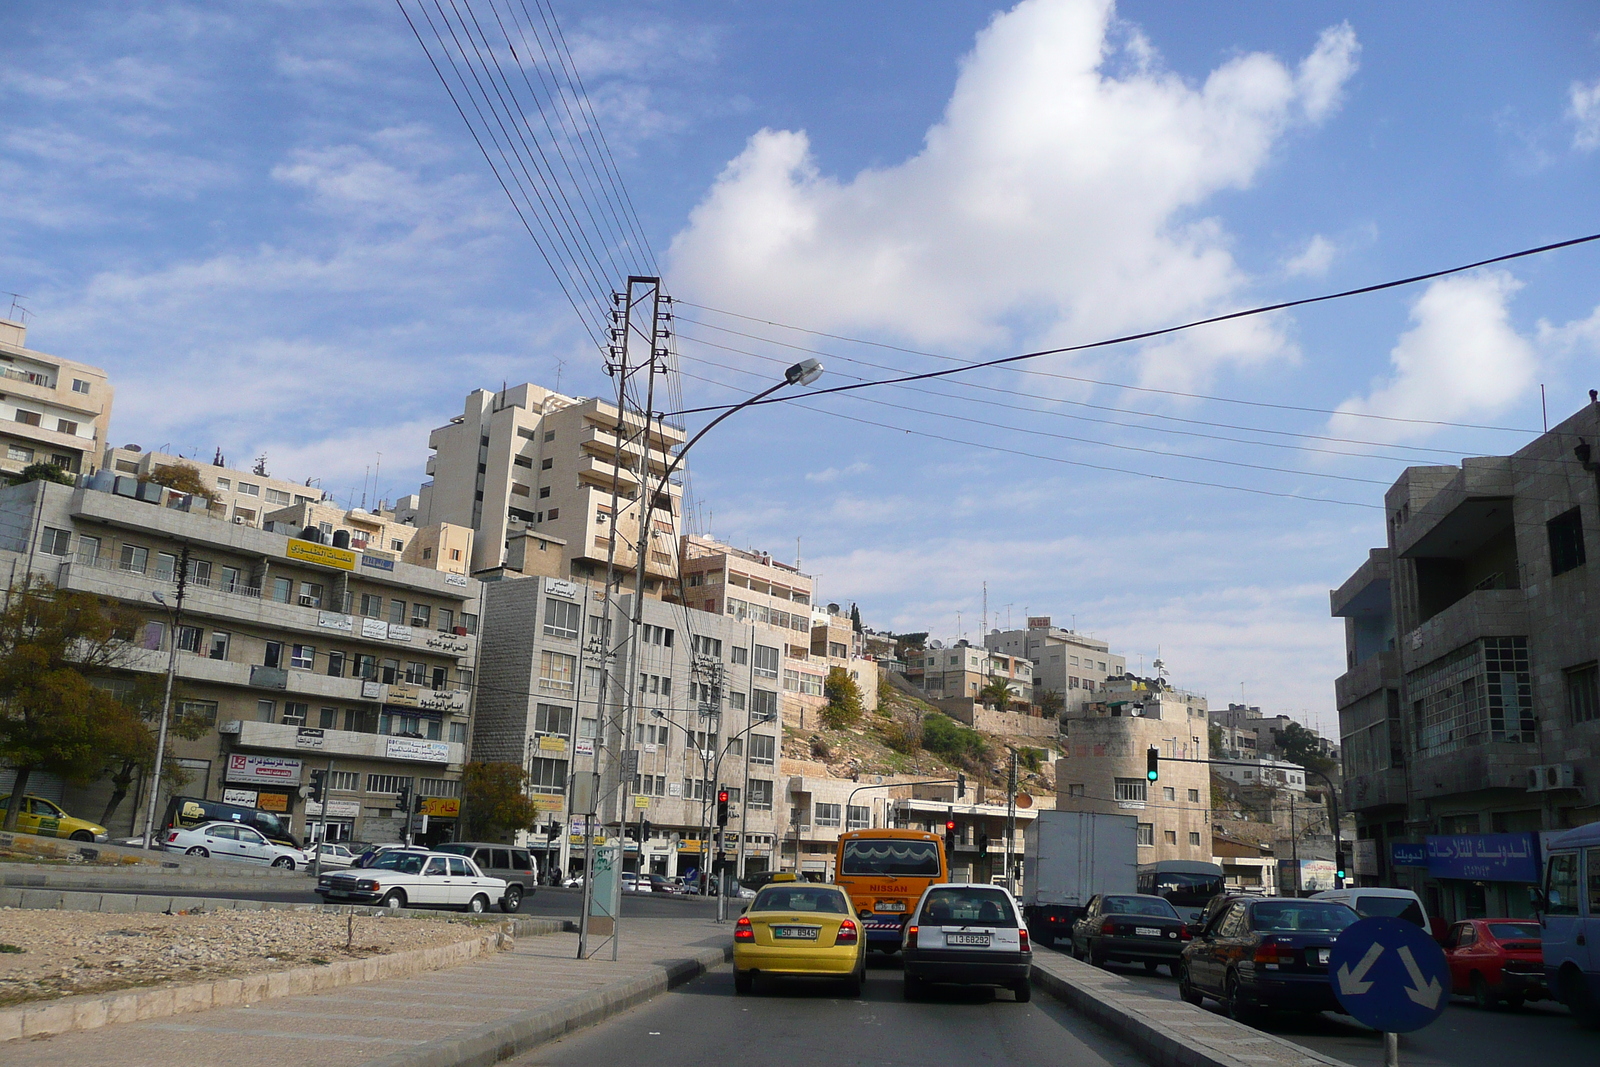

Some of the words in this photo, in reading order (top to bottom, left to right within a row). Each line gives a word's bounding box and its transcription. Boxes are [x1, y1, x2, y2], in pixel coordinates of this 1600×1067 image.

[1428, 838, 1472, 863] للثلاجات
[1475, 838, 1532, 867] الدويك
[869, 884, 908, 893] NISSAN
